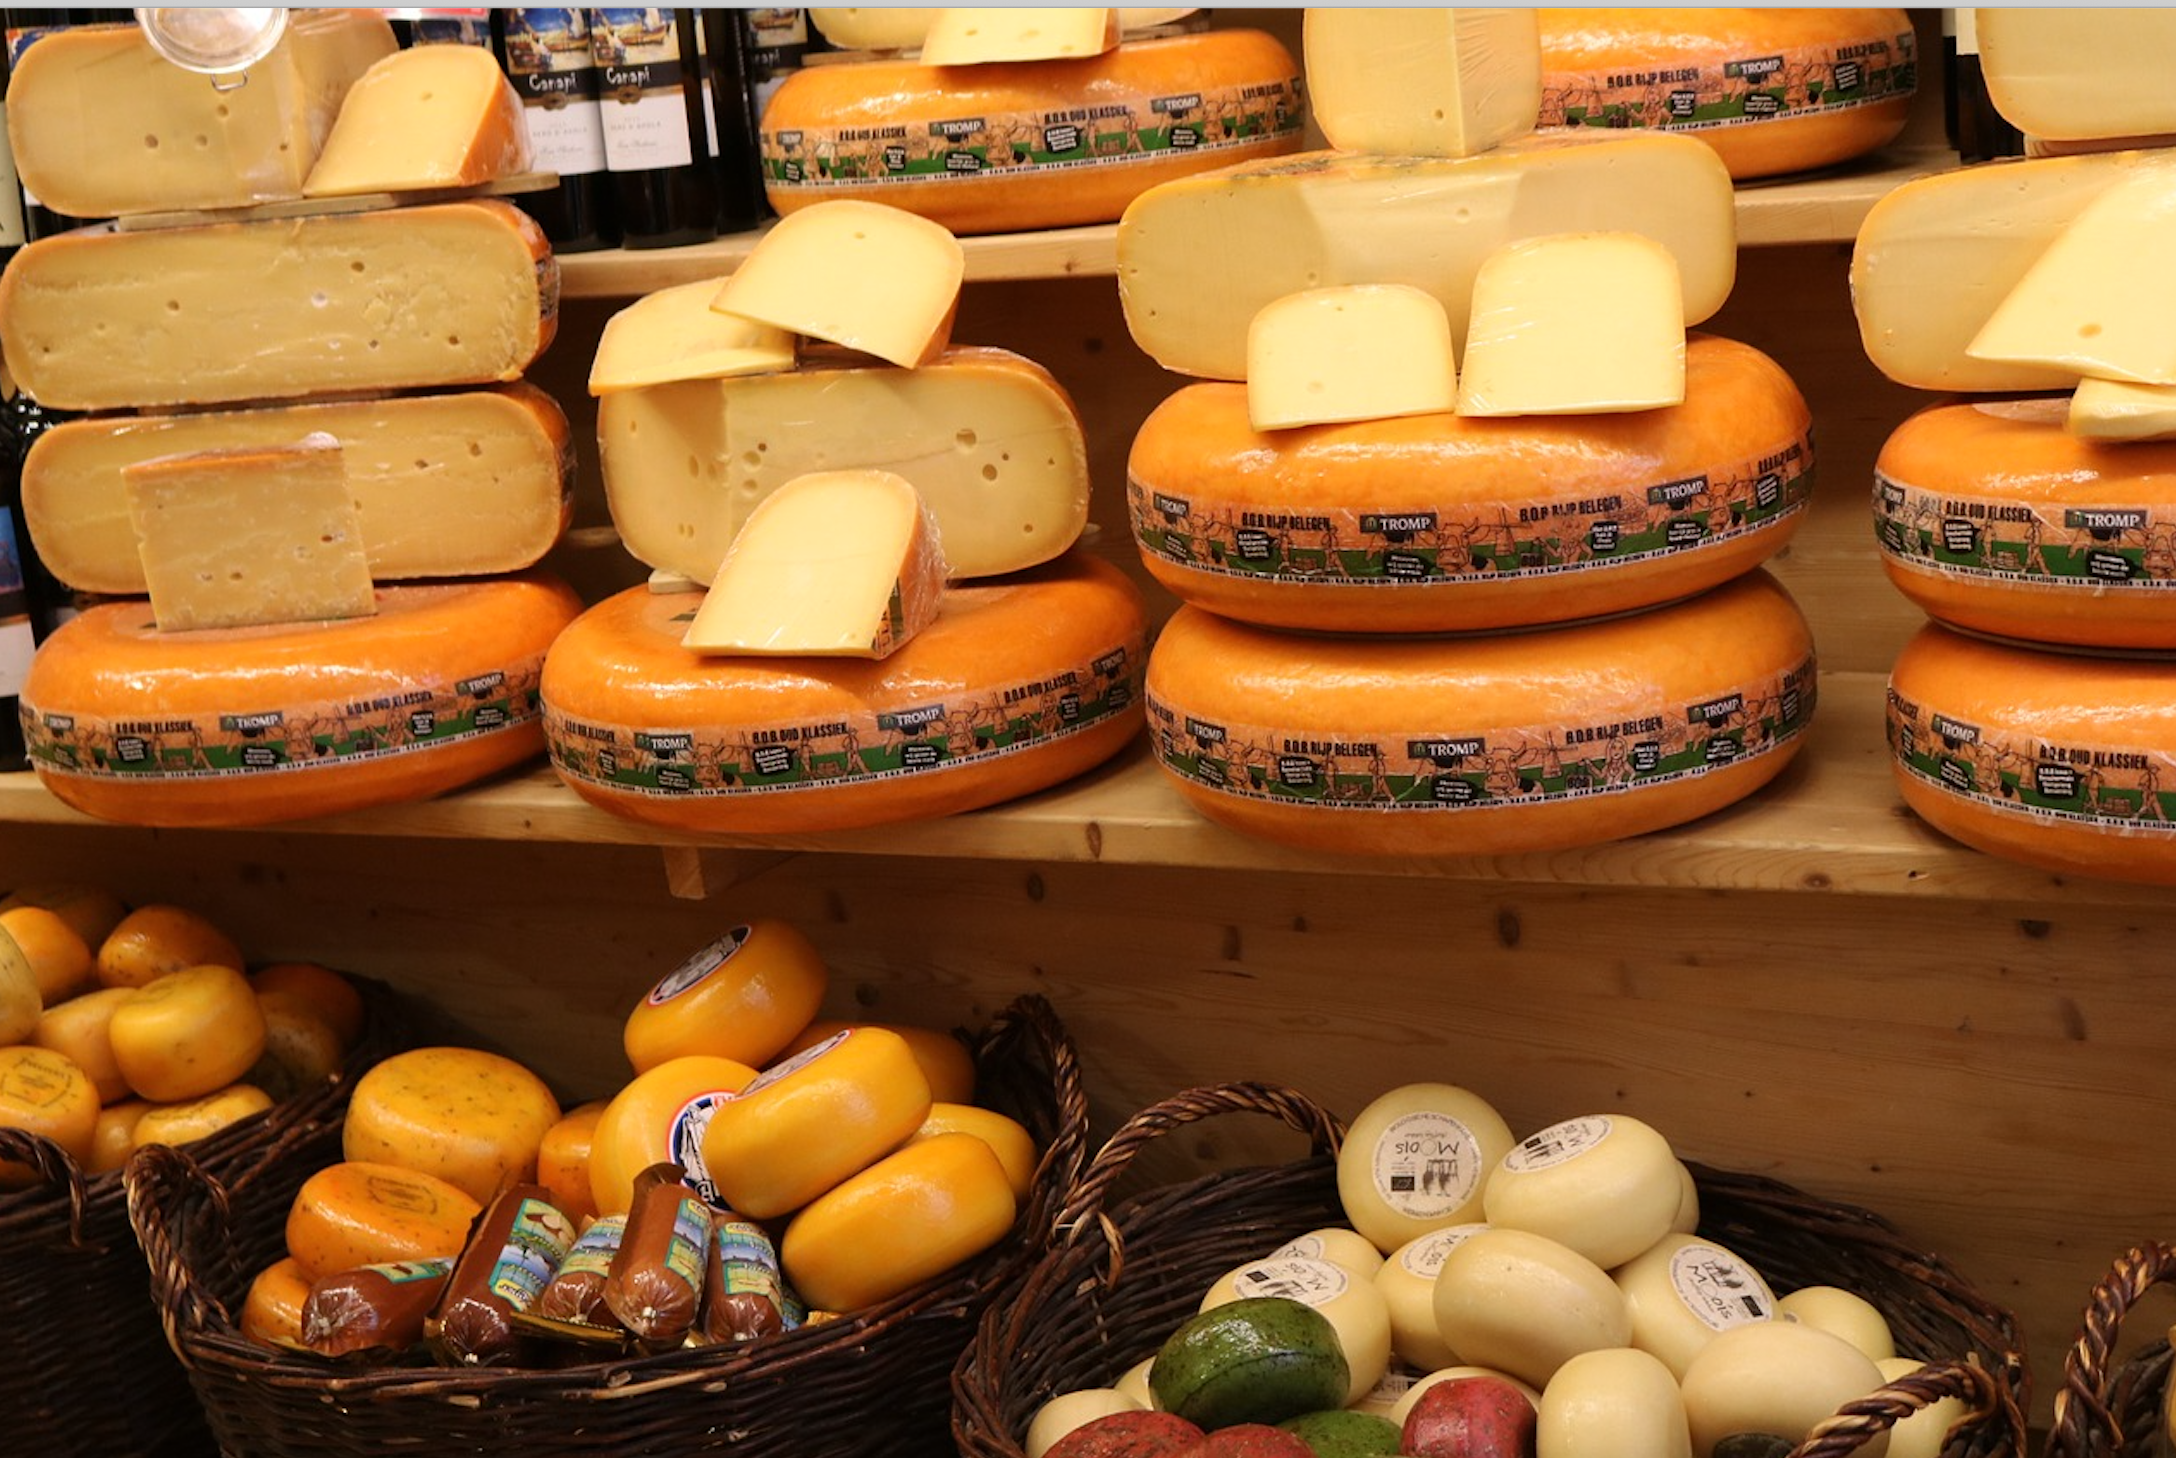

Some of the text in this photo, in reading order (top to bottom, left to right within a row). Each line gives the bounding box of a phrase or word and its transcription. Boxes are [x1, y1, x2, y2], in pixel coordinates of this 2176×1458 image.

[606, 65, 650, 86] Canapi
[1741, 60, 1780, 74] TROMP
[529, 72, 577, 93] Canapi
[942, 121, 981, 134] TROMP
[1663, 481, 1704, 499] TROMP
[1378, 517, 1431, 531] TROMP
[2084, 513, 2141, 528] TROMP
[1703, 697, 1740, 719] TROMP
[897, 708, 940, 727] TROMP
[1941, 720, 1976, 742] TROMP
[651, 736, 688, 750] TROMP
[1428, 741, 1479, 757] TROMP
